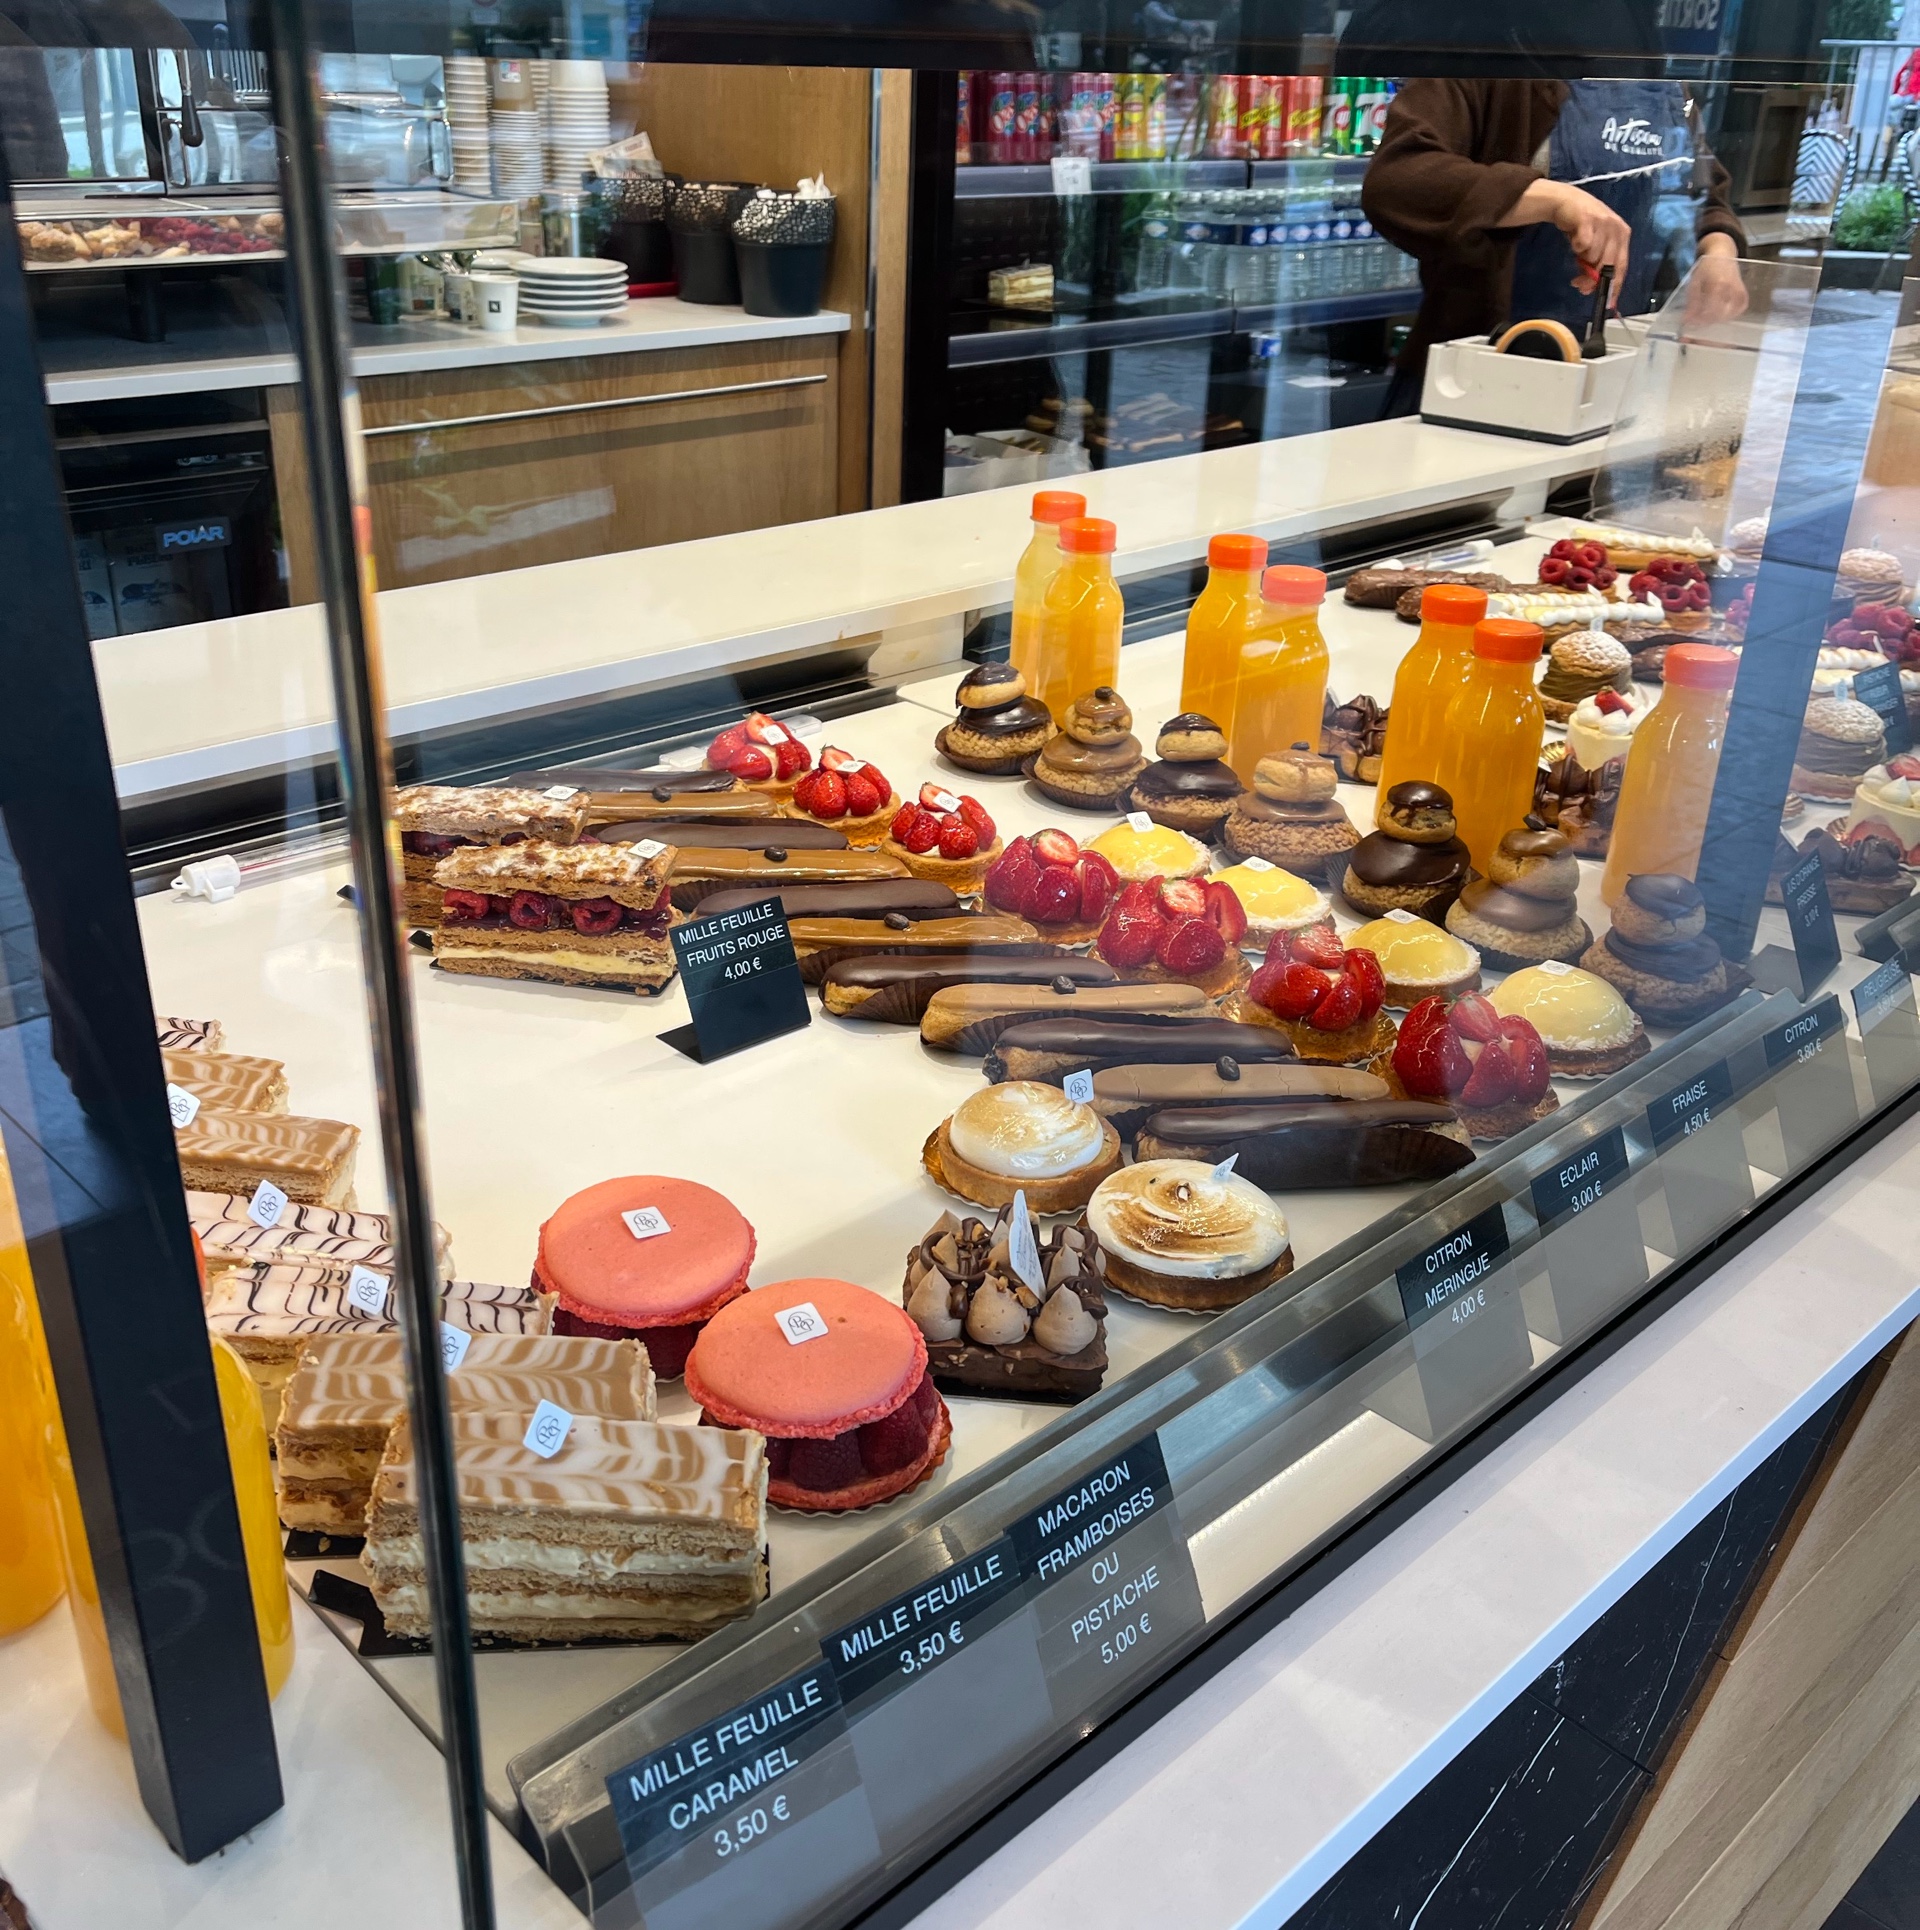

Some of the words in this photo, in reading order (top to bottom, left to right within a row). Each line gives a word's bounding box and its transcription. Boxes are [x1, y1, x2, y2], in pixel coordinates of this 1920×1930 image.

[163, 524, 225, 548] POLAR
[678, 921, 720, 945] MILLE
[720, 903, 774, 932] FEUILLE
[686, 941, 736, 968] FRUITS
[737, 924, 786, 951] ROUGE
[724, 960, 751, 980] 4,00
[753, 957, 762, 971] €
[1785, 1013, 1818, 1043] CITRON
[1797, 1042, 1815, 1063] 3,80
[1816, 1037, 1822, 1052] €
[1672, 1080, 1708, 1114] FRAISE
[1684, 1112, 1703, 1136] 4,50
[1703, 1107, 1711, 1123] €
[1559, 1151, 1600, 1189] ECLAIR
[1571, 1186, 1594, 1213] 3,00
[1594, 1180, 1603, 1197] €
[1425, 1230, 1473, 1274] CITRON
[1424, 1251, 1491, 1309] MERINGUE
[1451, 1296, 1476, 1324] 4,00
[1477, 1288, 1486, 1307] €
[1037, 1460, 1131, 1538] MACARON
[1036, 1486, 1155, 1581] FRAMBOISES
[1091, 1551, 1120, 1585] OU
[840, 1606, 911, 1663] MILLE
[913, 1554, 1003, 1622] FEUILLE
[1071, 1565, 1160, 1644] PISTACHE
[899, 1631, 945, 1674] 3,50
[948, 1620, 965, 1644] €
[1100, 1624, 1137, 1665] 5,00
[1139, 1612, 1152, 1634] €
[629, 1737, 713, 1801] MILLE
[715, 1678, 823, 1754] FEUILLE
[669, 1746, 799, 1830] CARAMEL
[714, 1808, 768, 1857] 3,50
[772, 1794, 791, 1821] €
